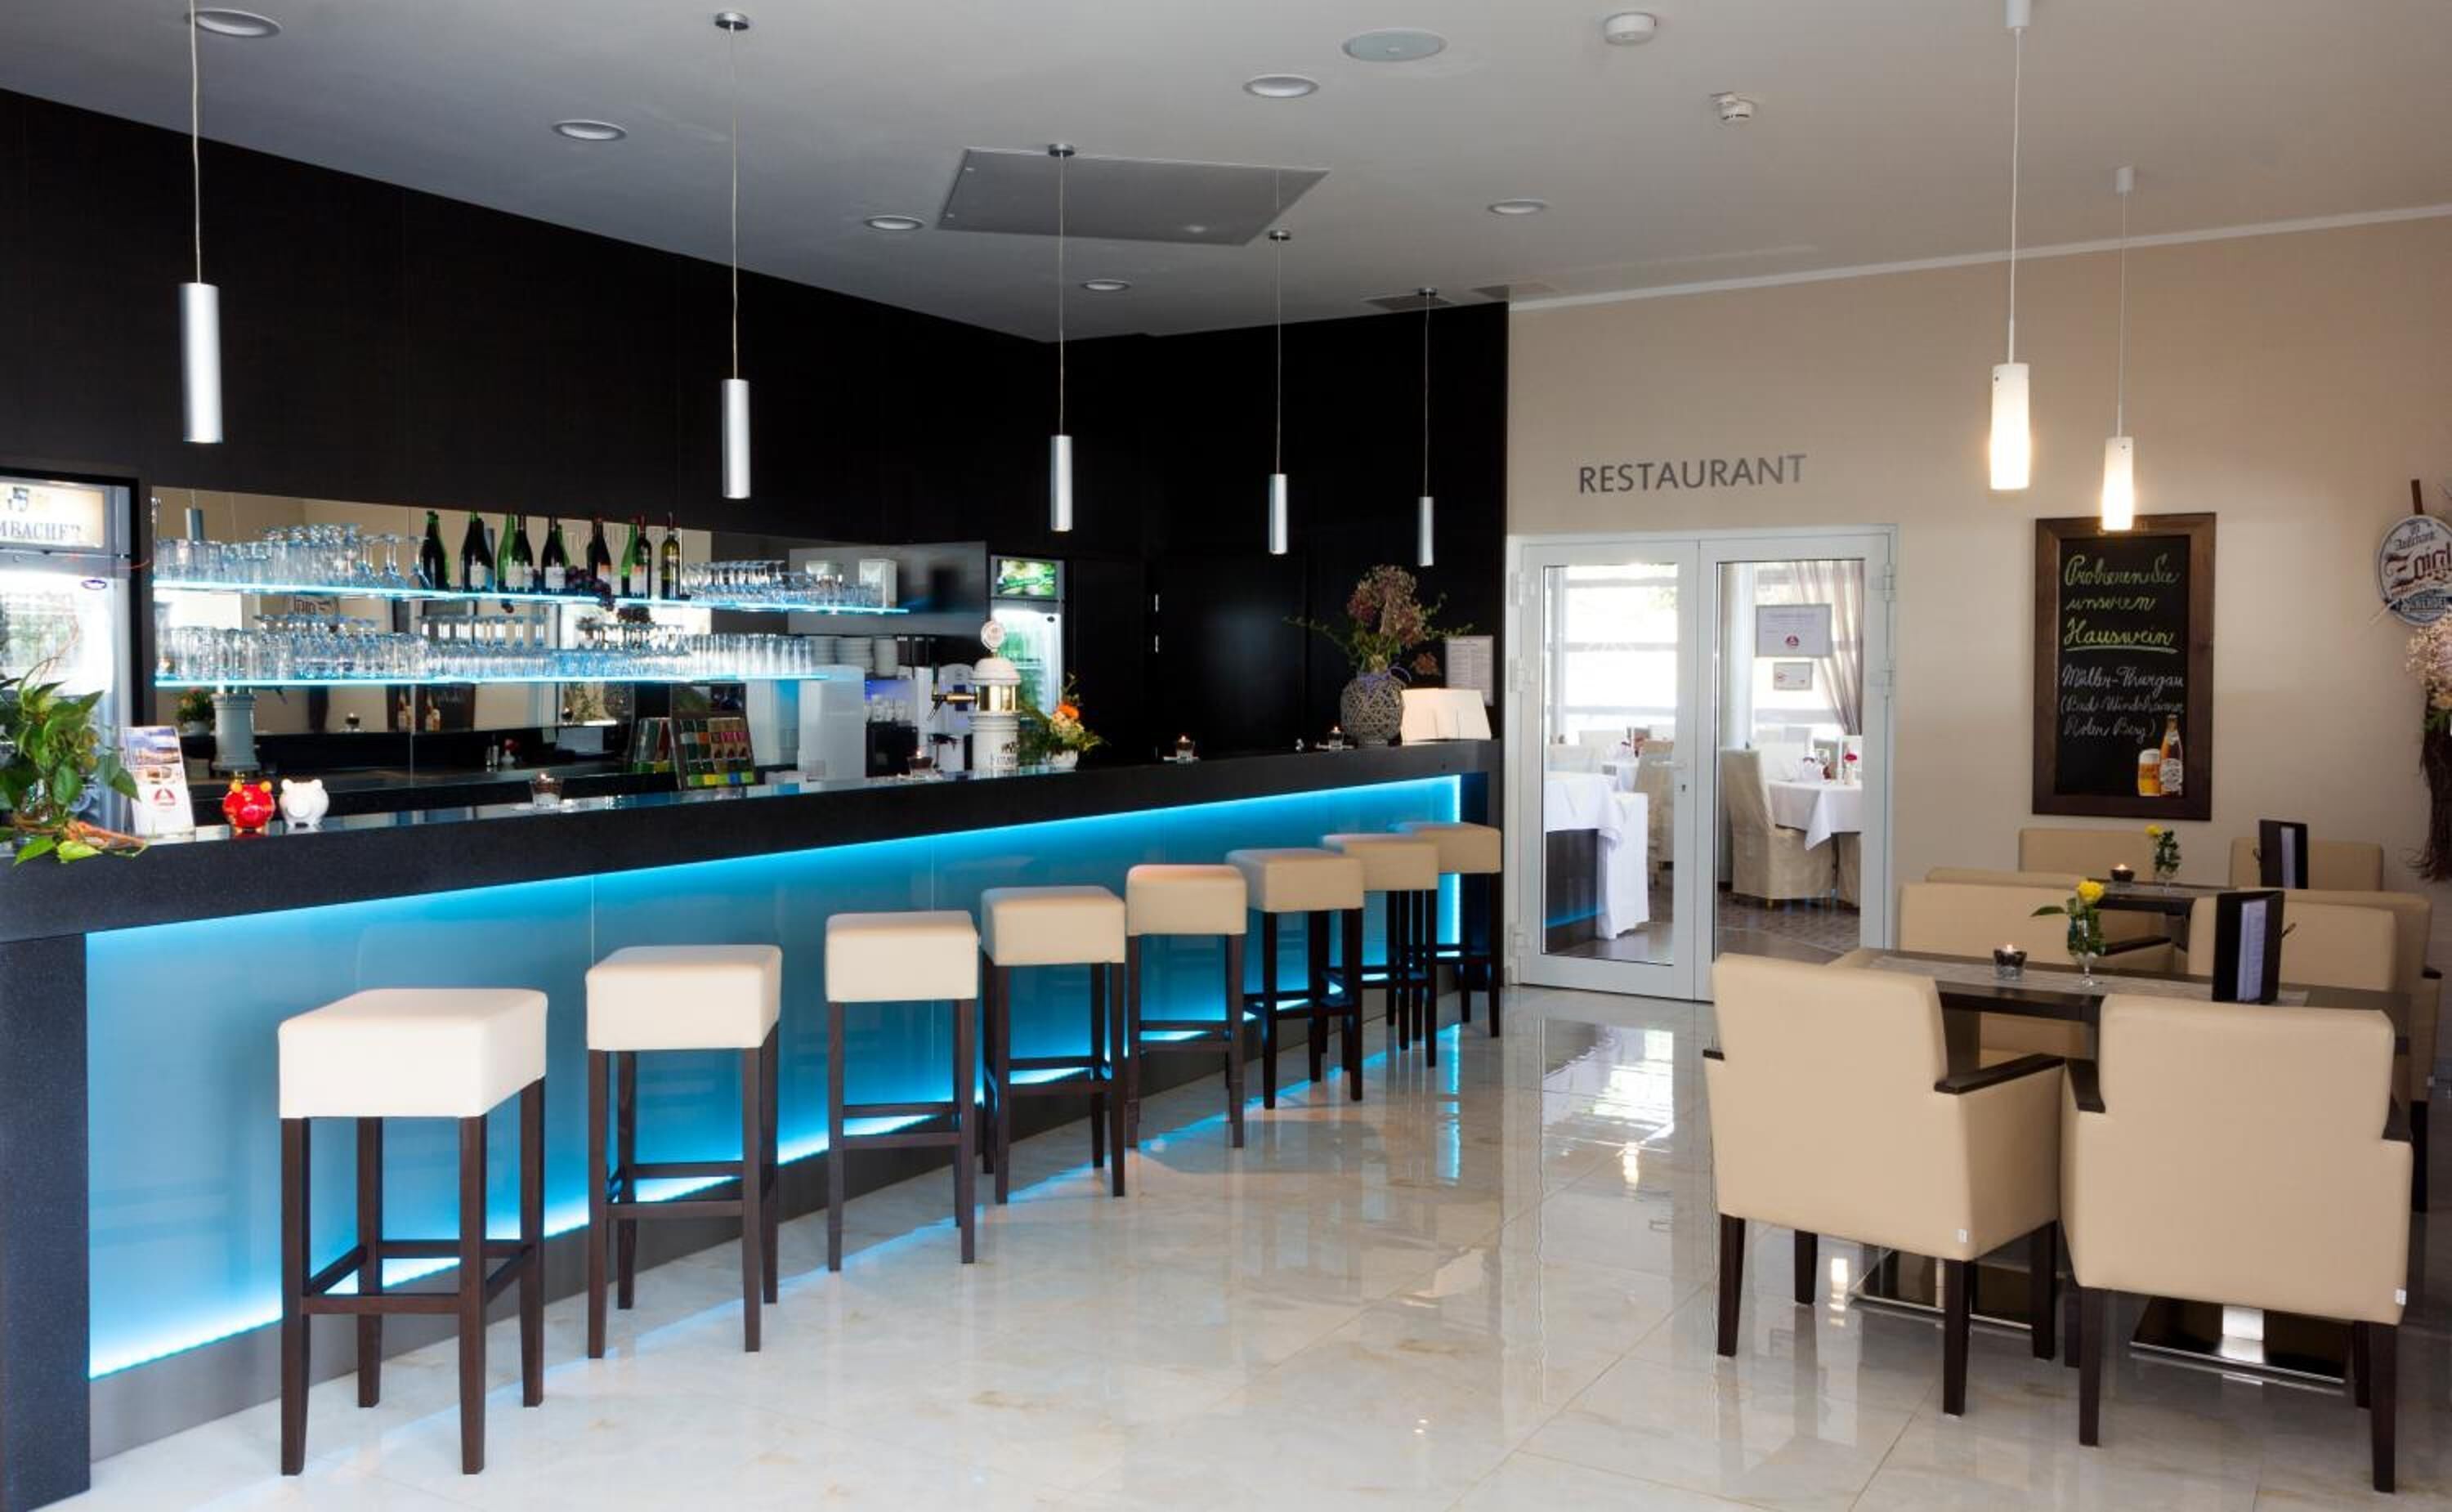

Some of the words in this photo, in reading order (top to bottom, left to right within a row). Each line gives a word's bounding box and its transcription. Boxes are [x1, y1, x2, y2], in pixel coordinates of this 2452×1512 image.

[1578, 454, 1808, 494] RESTAURANT
[2064, 554, 2149, 586] Probieren
[2150, 553, 2180, 584] Sie
[2065, 595, 2157, 612] unseren
[2063, 616, 2175, 646] Hauswein
